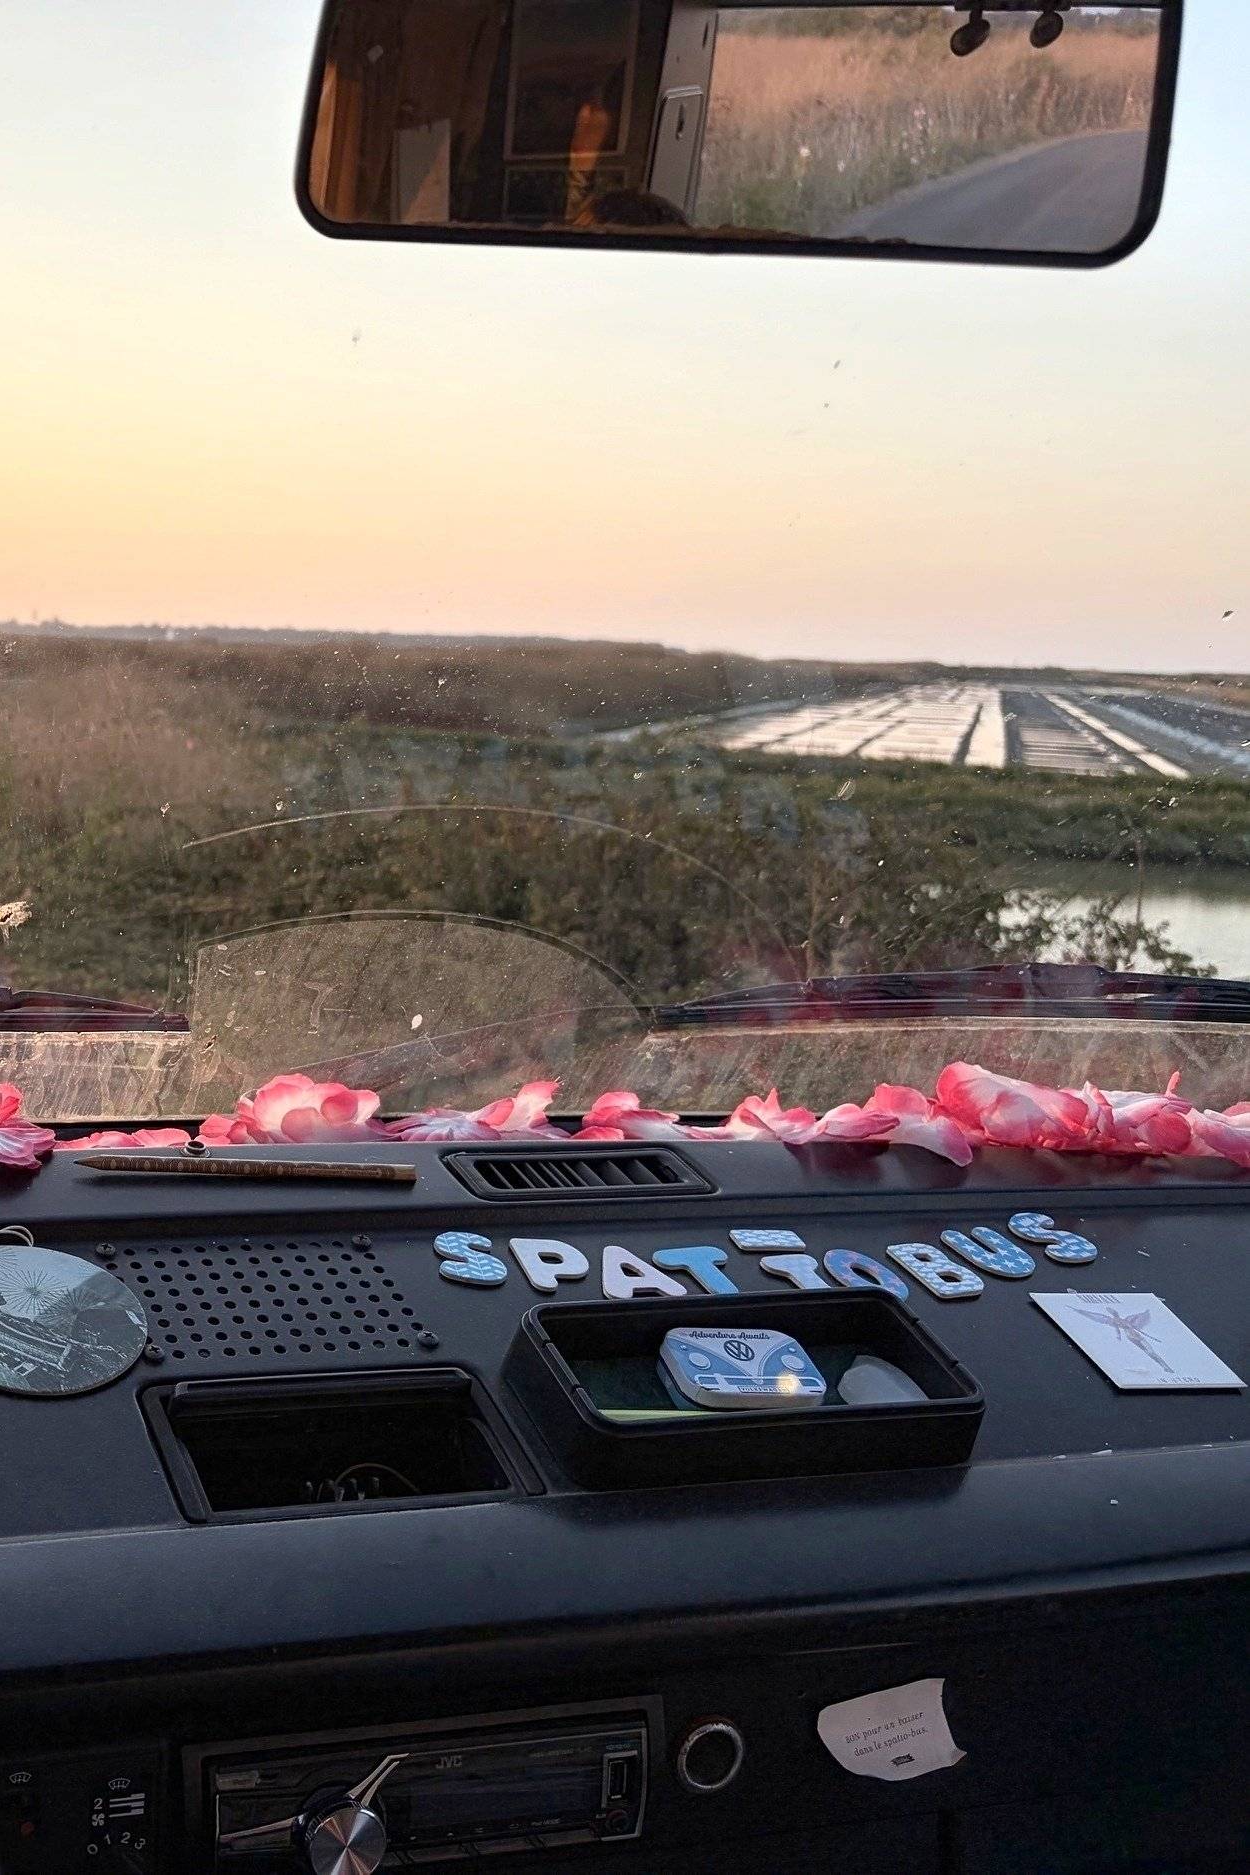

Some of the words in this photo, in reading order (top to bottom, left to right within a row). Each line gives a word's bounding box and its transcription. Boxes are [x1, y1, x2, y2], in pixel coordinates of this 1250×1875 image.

[688, 1330, 737, 1339] Adventure
[738, 1331, 771, 1340] Awaits
[862, 1725, 881, 1742] pour
[853, 1744, 874, 1757] dans
[874, 1739, 882, 1750] le
[435, 1755, 463, 1769] JVC
[93, 1797, 103, 1810] 2
[120, 1831, 132, 1844] 2
[134, 1838, 147, 1850] 3
